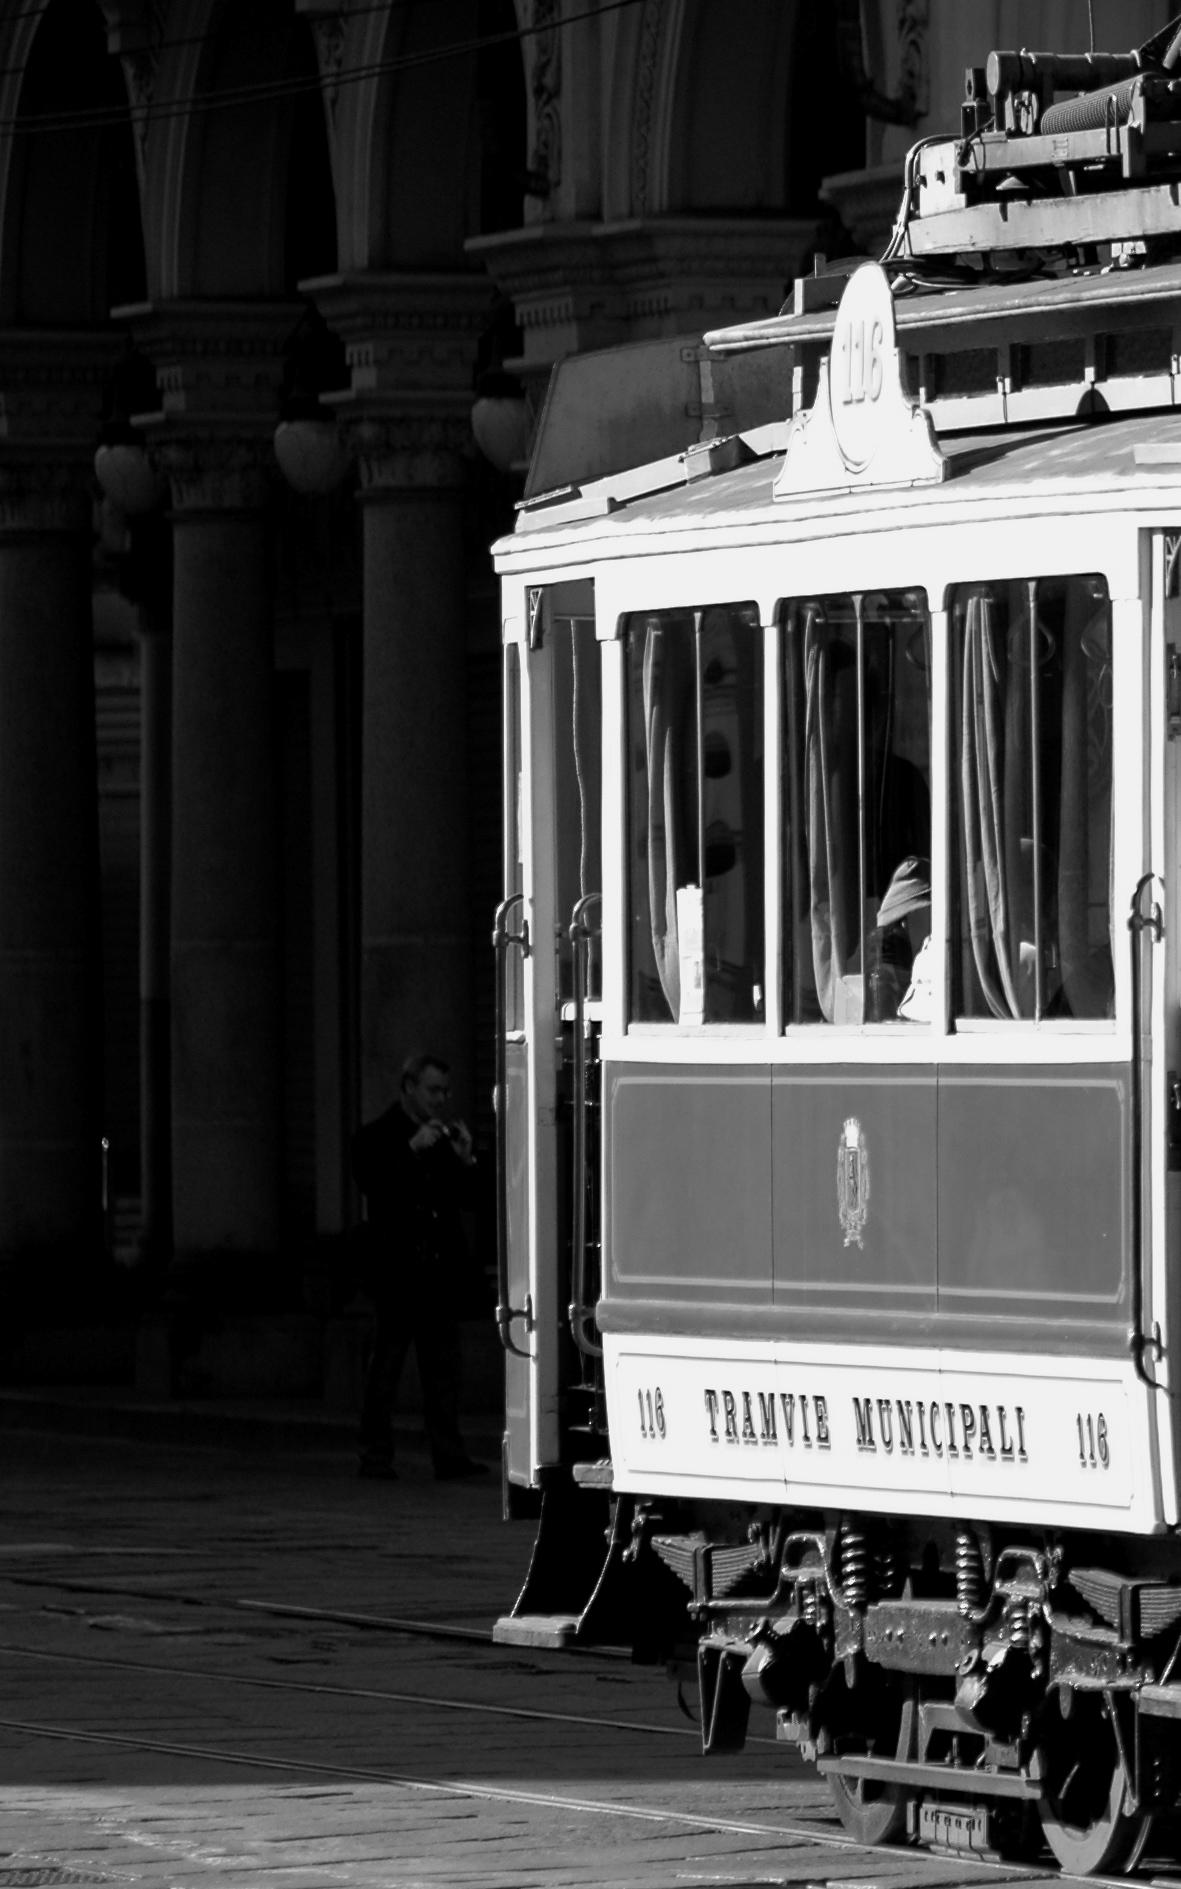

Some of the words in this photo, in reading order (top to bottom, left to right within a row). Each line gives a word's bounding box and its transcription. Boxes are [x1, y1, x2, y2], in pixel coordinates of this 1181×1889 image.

[841, 320, 884, 406] 116
[637, 1386, 666, 1440] 116
[704, 1388, 831, 1451] TRAMVIE
[851, 1396, 1029, 1464] MUNICIPALI
[1075, 1411, 1110, 1470] 116
